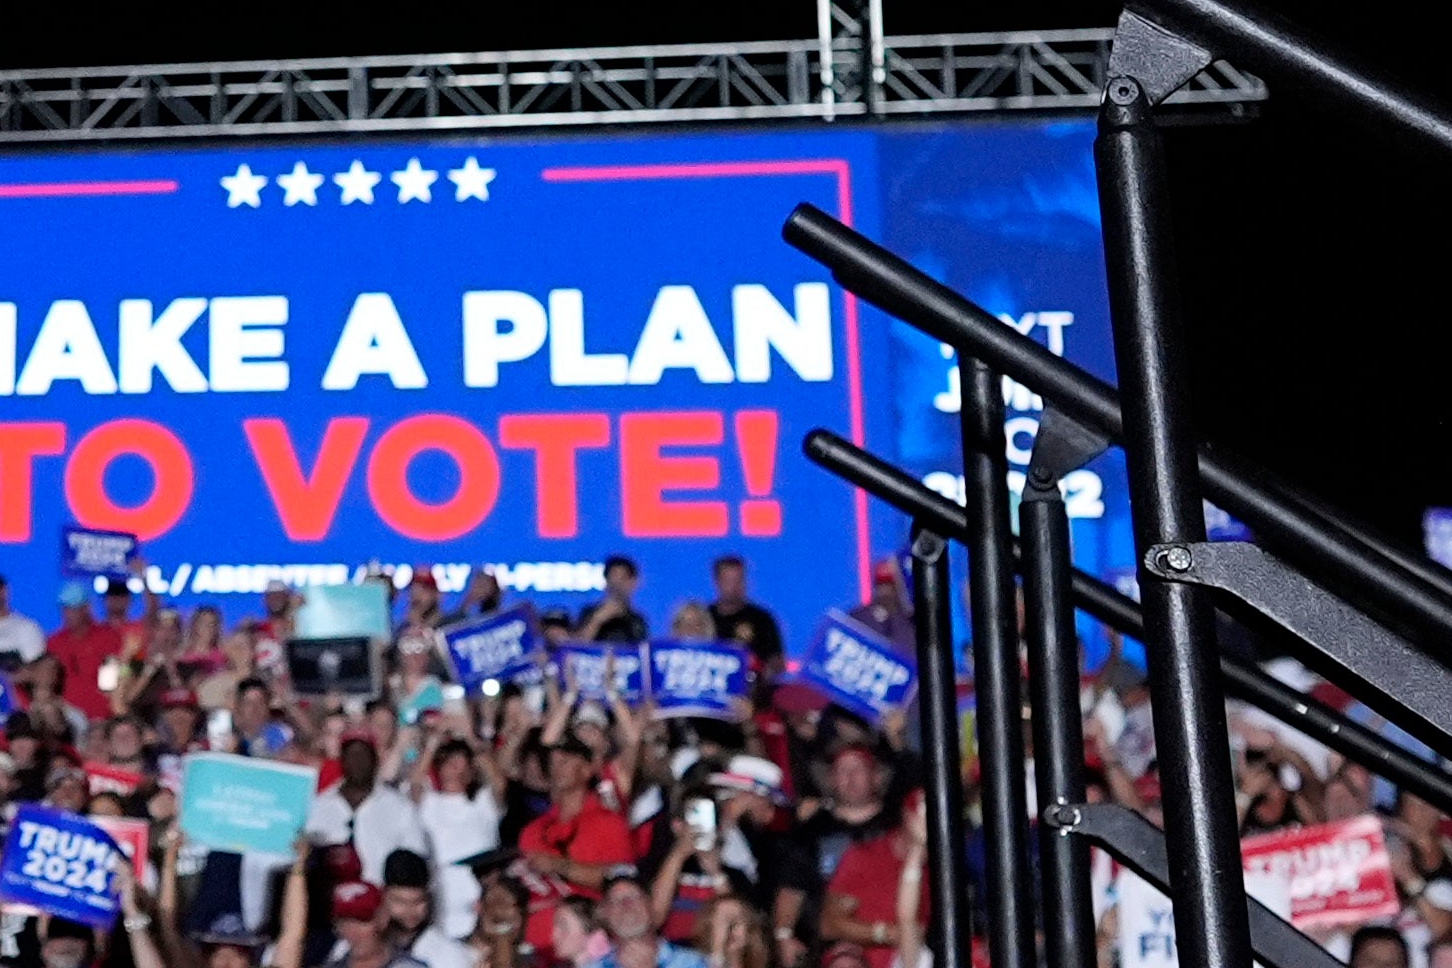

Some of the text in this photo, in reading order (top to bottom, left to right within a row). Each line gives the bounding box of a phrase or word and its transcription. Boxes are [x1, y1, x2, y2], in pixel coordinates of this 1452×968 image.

[322, 293, 428, 390] A
[463, 282, 833, 388] PLAN
[244, 409, 782, 542] VOTE!
[22, 849, 107, 893] 2024
